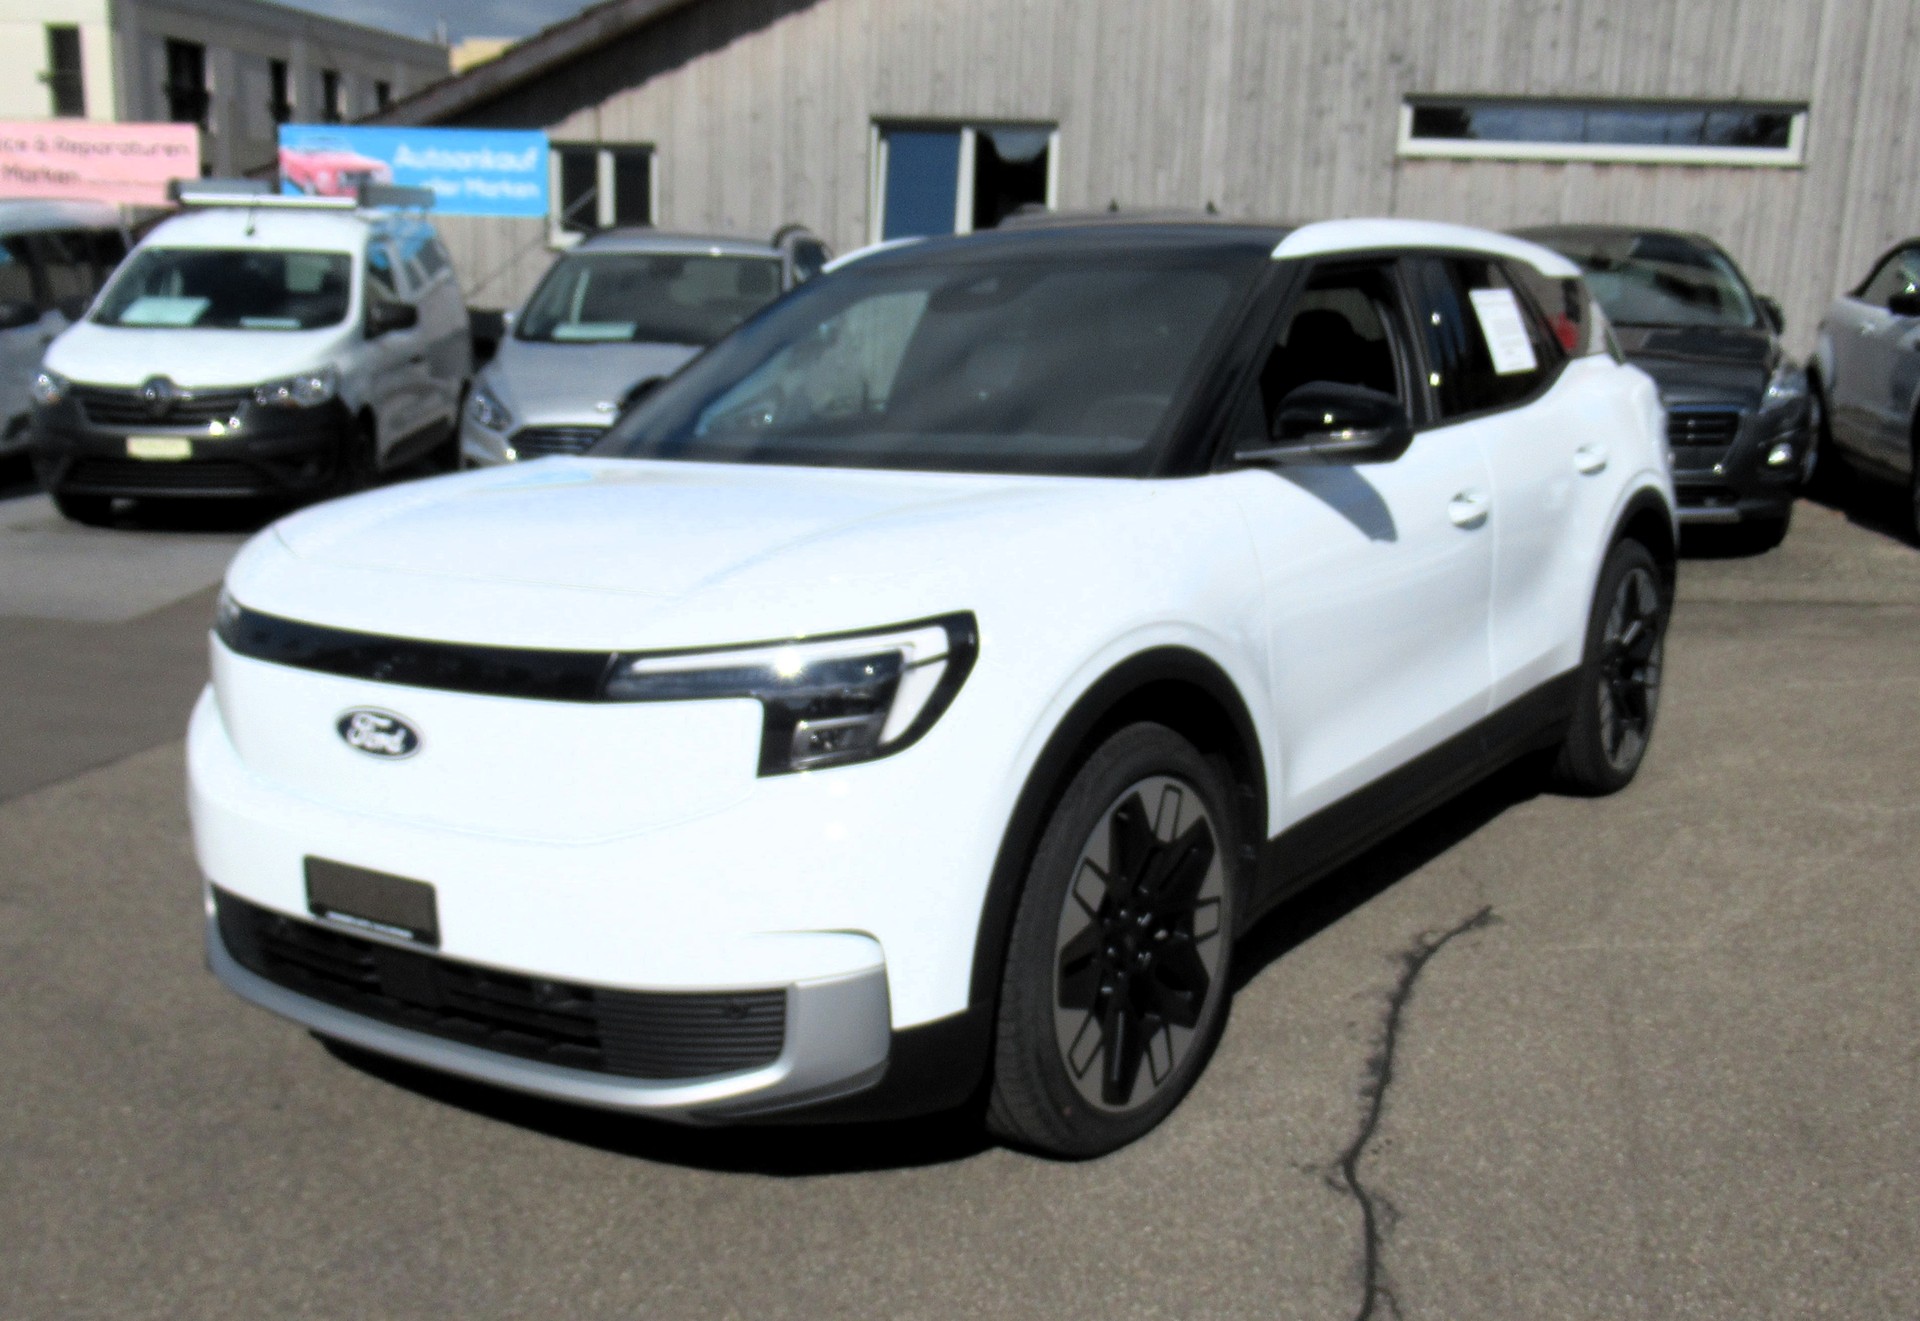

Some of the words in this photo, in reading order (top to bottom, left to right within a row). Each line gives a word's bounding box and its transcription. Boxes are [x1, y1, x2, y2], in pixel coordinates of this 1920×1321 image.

[53, 134, 190, 158] Reparaturen
[395, 144, 538, 172] Autoankauf
[2, 163, 80, 185] Marken
[464, 178, 541, 199] Marken
[347, 713, 405, 753] Ford
